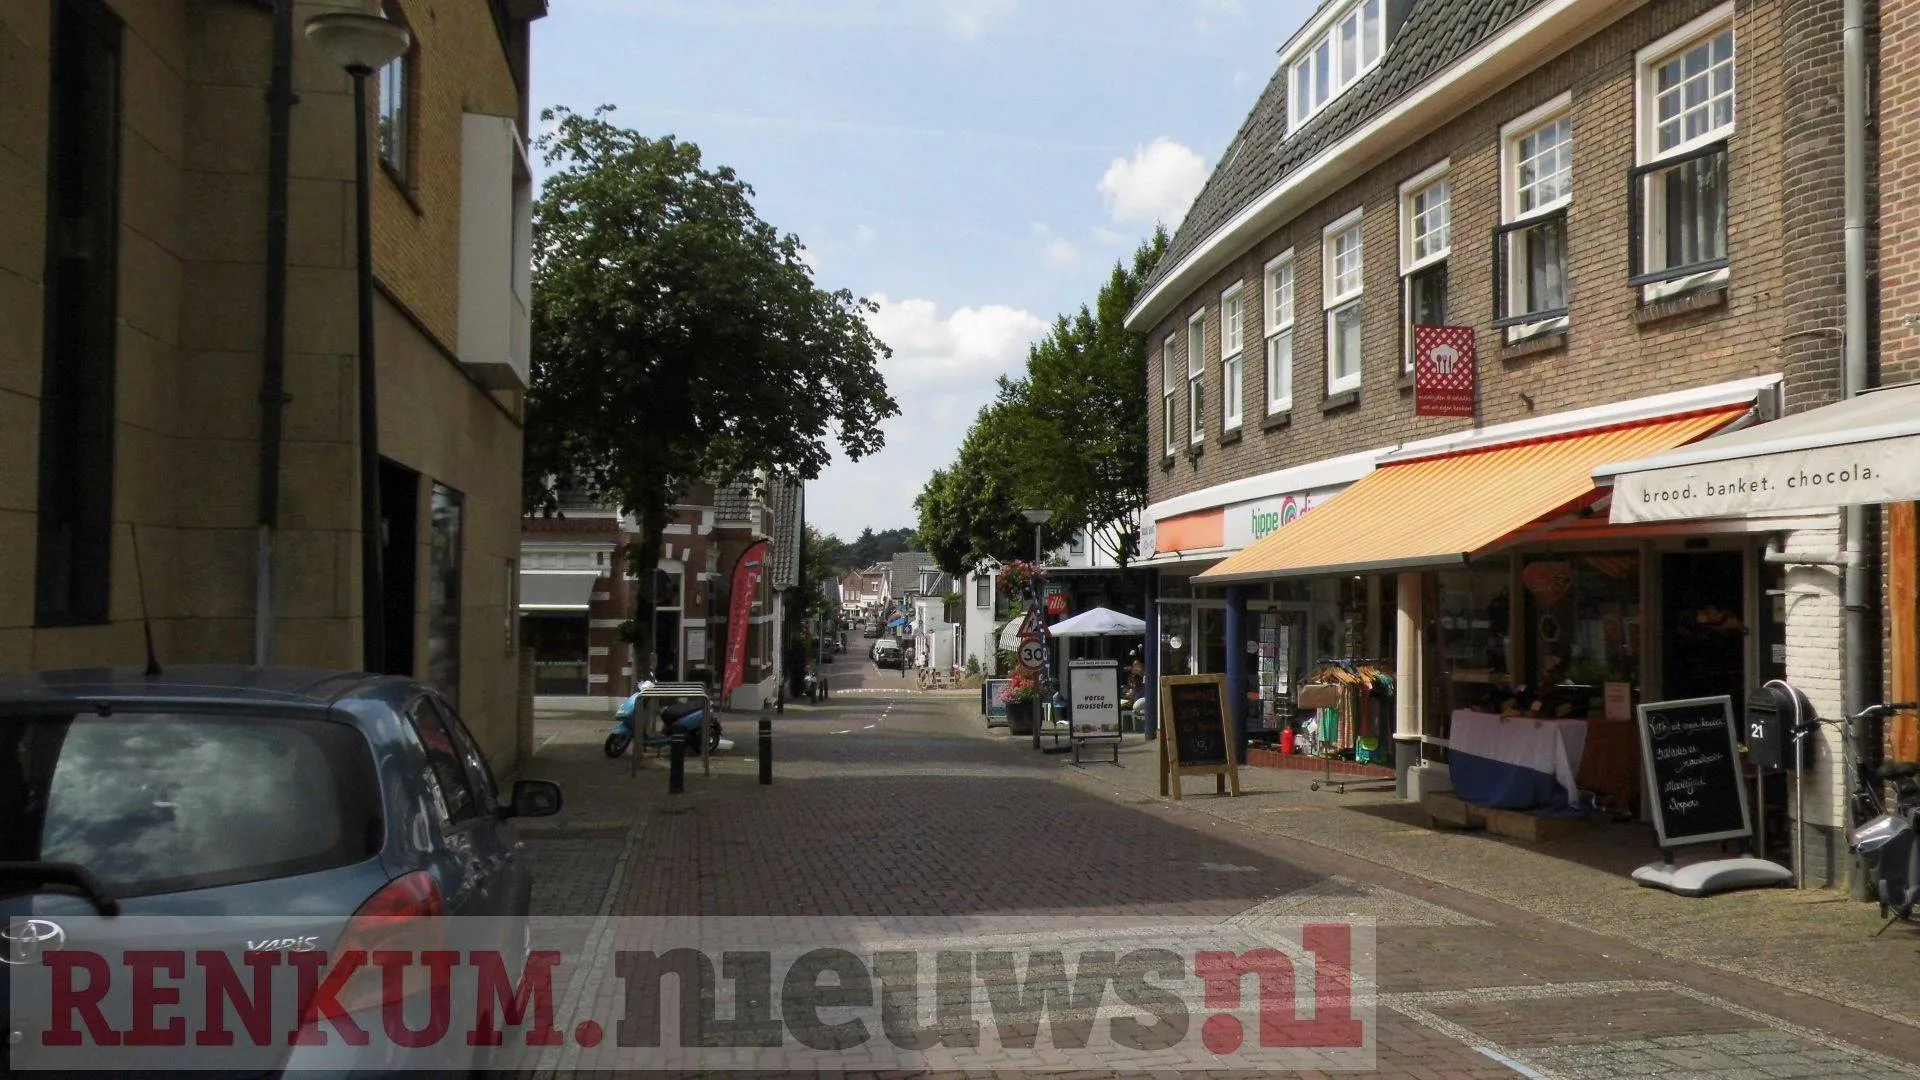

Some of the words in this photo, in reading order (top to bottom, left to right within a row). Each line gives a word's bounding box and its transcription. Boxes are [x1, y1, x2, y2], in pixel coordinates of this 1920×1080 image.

[1643, 485, 1698, 503] brood.
[1706, 477, 1775, 497] banket.
[1787, 463, 1880, 489] chocola.
[1251, 508, 1279, 540] hippe
[1023, 648, 1043, 662] 30
[1084, 694, 1106, 702] verse
[1076, 702, 1114, 710] mosselen
[1751, 723, 1764, 738] 21
